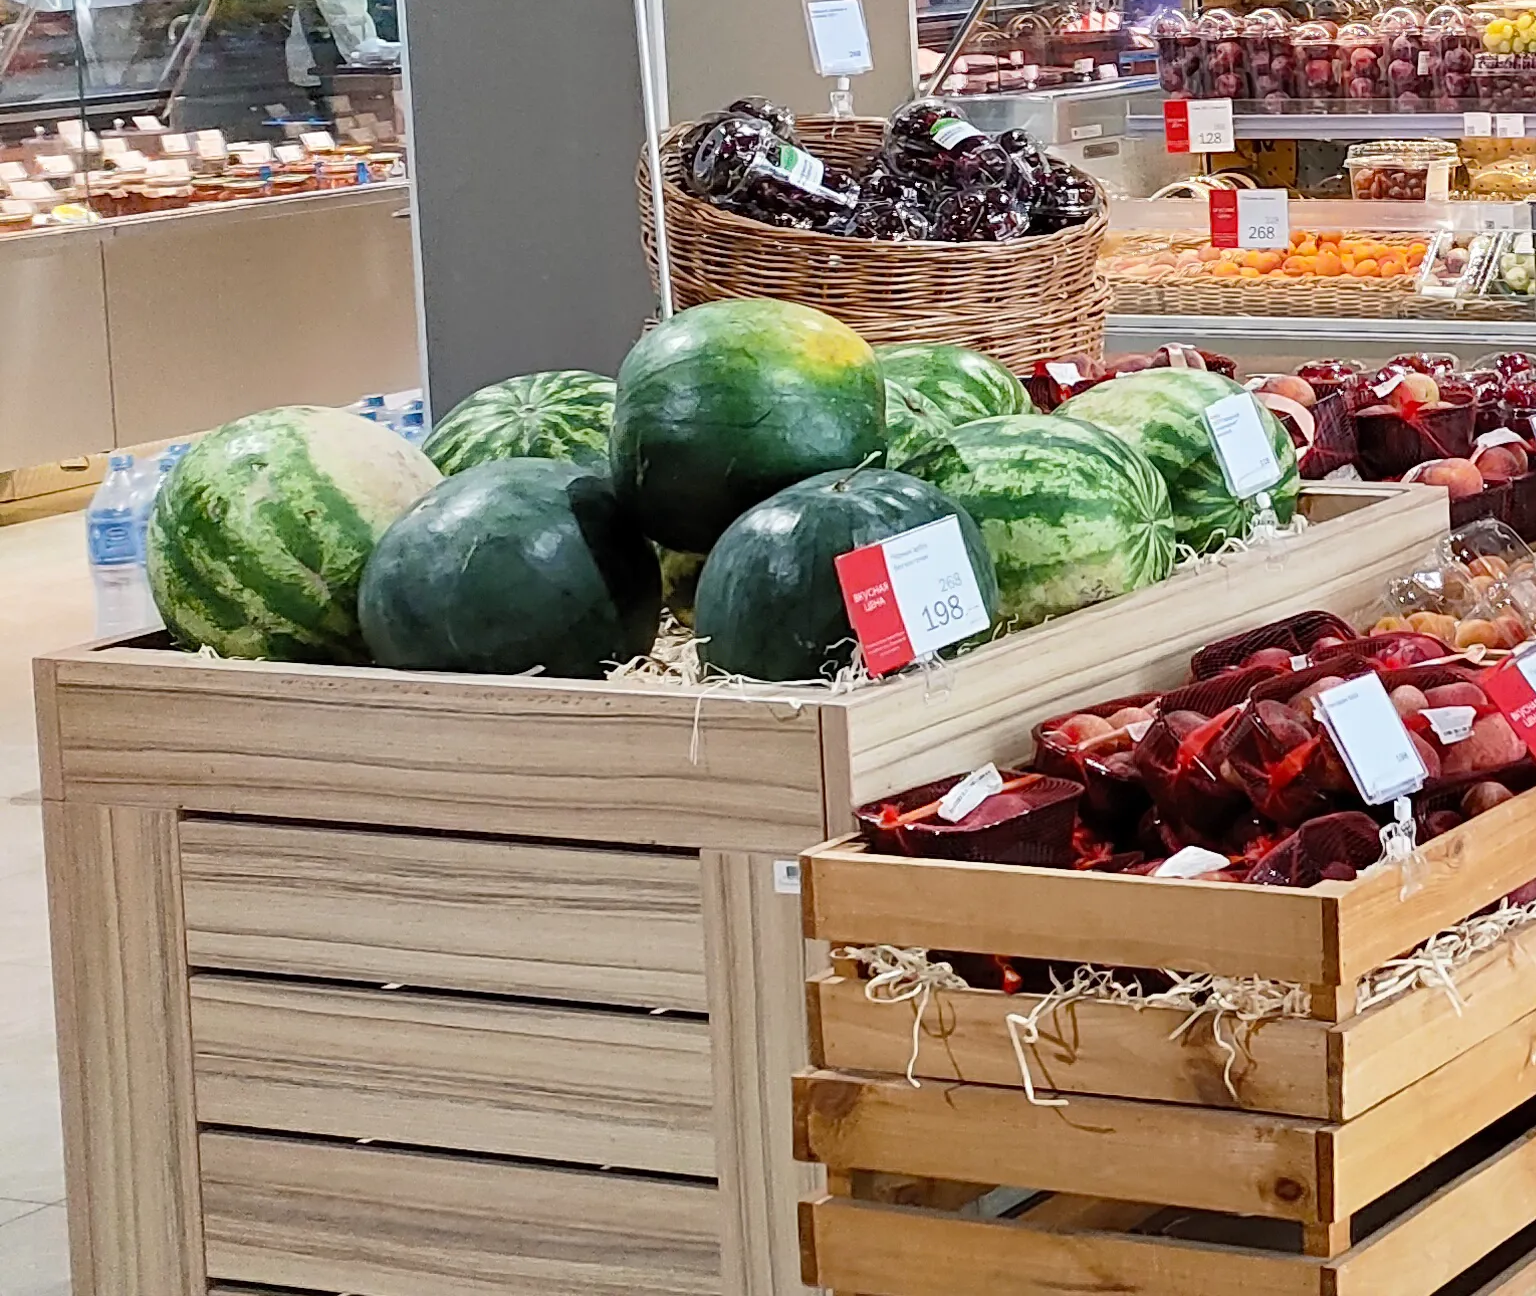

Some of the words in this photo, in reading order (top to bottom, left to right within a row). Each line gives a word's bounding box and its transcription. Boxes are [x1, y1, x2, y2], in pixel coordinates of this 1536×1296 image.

[1199, 132, 1222, 144] 128
[1248, 226, 1275, 239] 268
[852, 582, 889, 603] ВКУСНАЯ
[864, 597, 887, 613] ЦЕНА
[921, 594, 964, 632] 198
